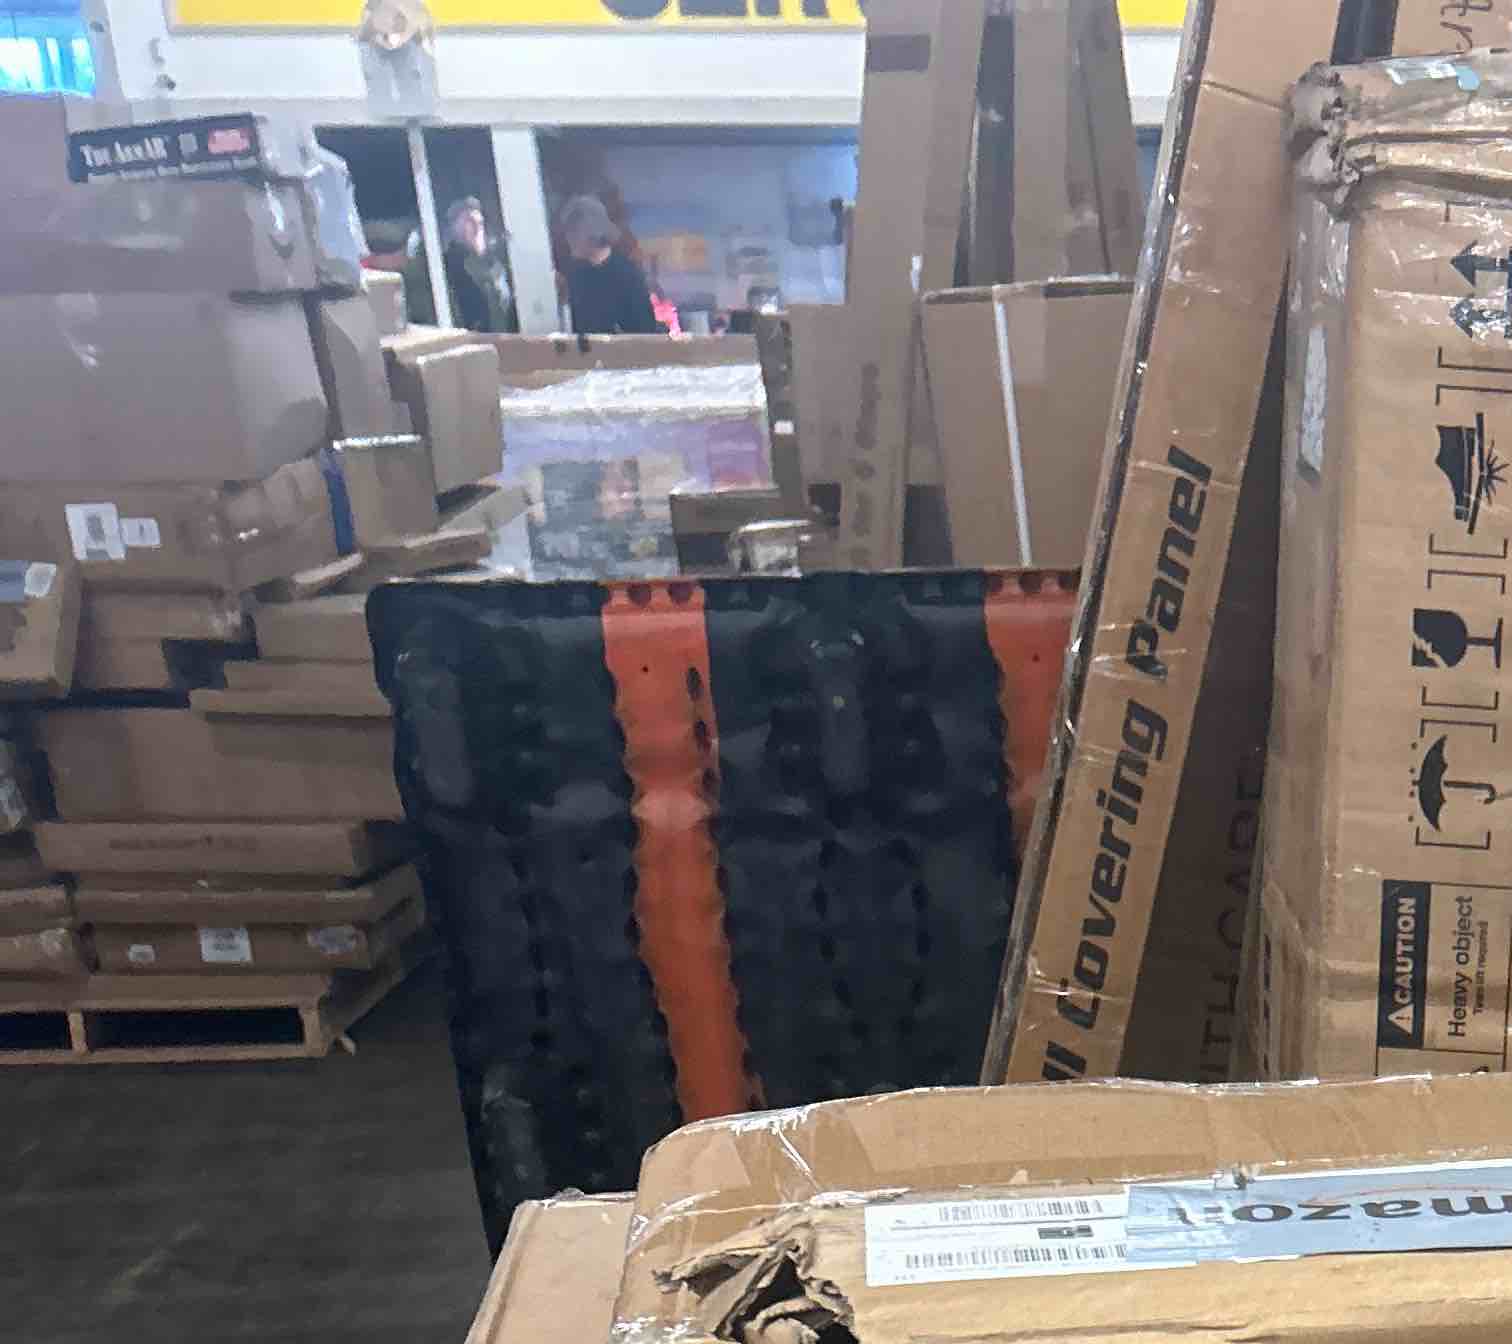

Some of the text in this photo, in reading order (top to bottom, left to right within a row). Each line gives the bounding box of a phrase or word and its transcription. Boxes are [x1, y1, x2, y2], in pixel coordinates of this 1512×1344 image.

[1056, 698, 1168, 1031] Covering
[1393, 896, 1417, 1005] CAUTION
[1448, 895, 1475, 1037] Heavy object
